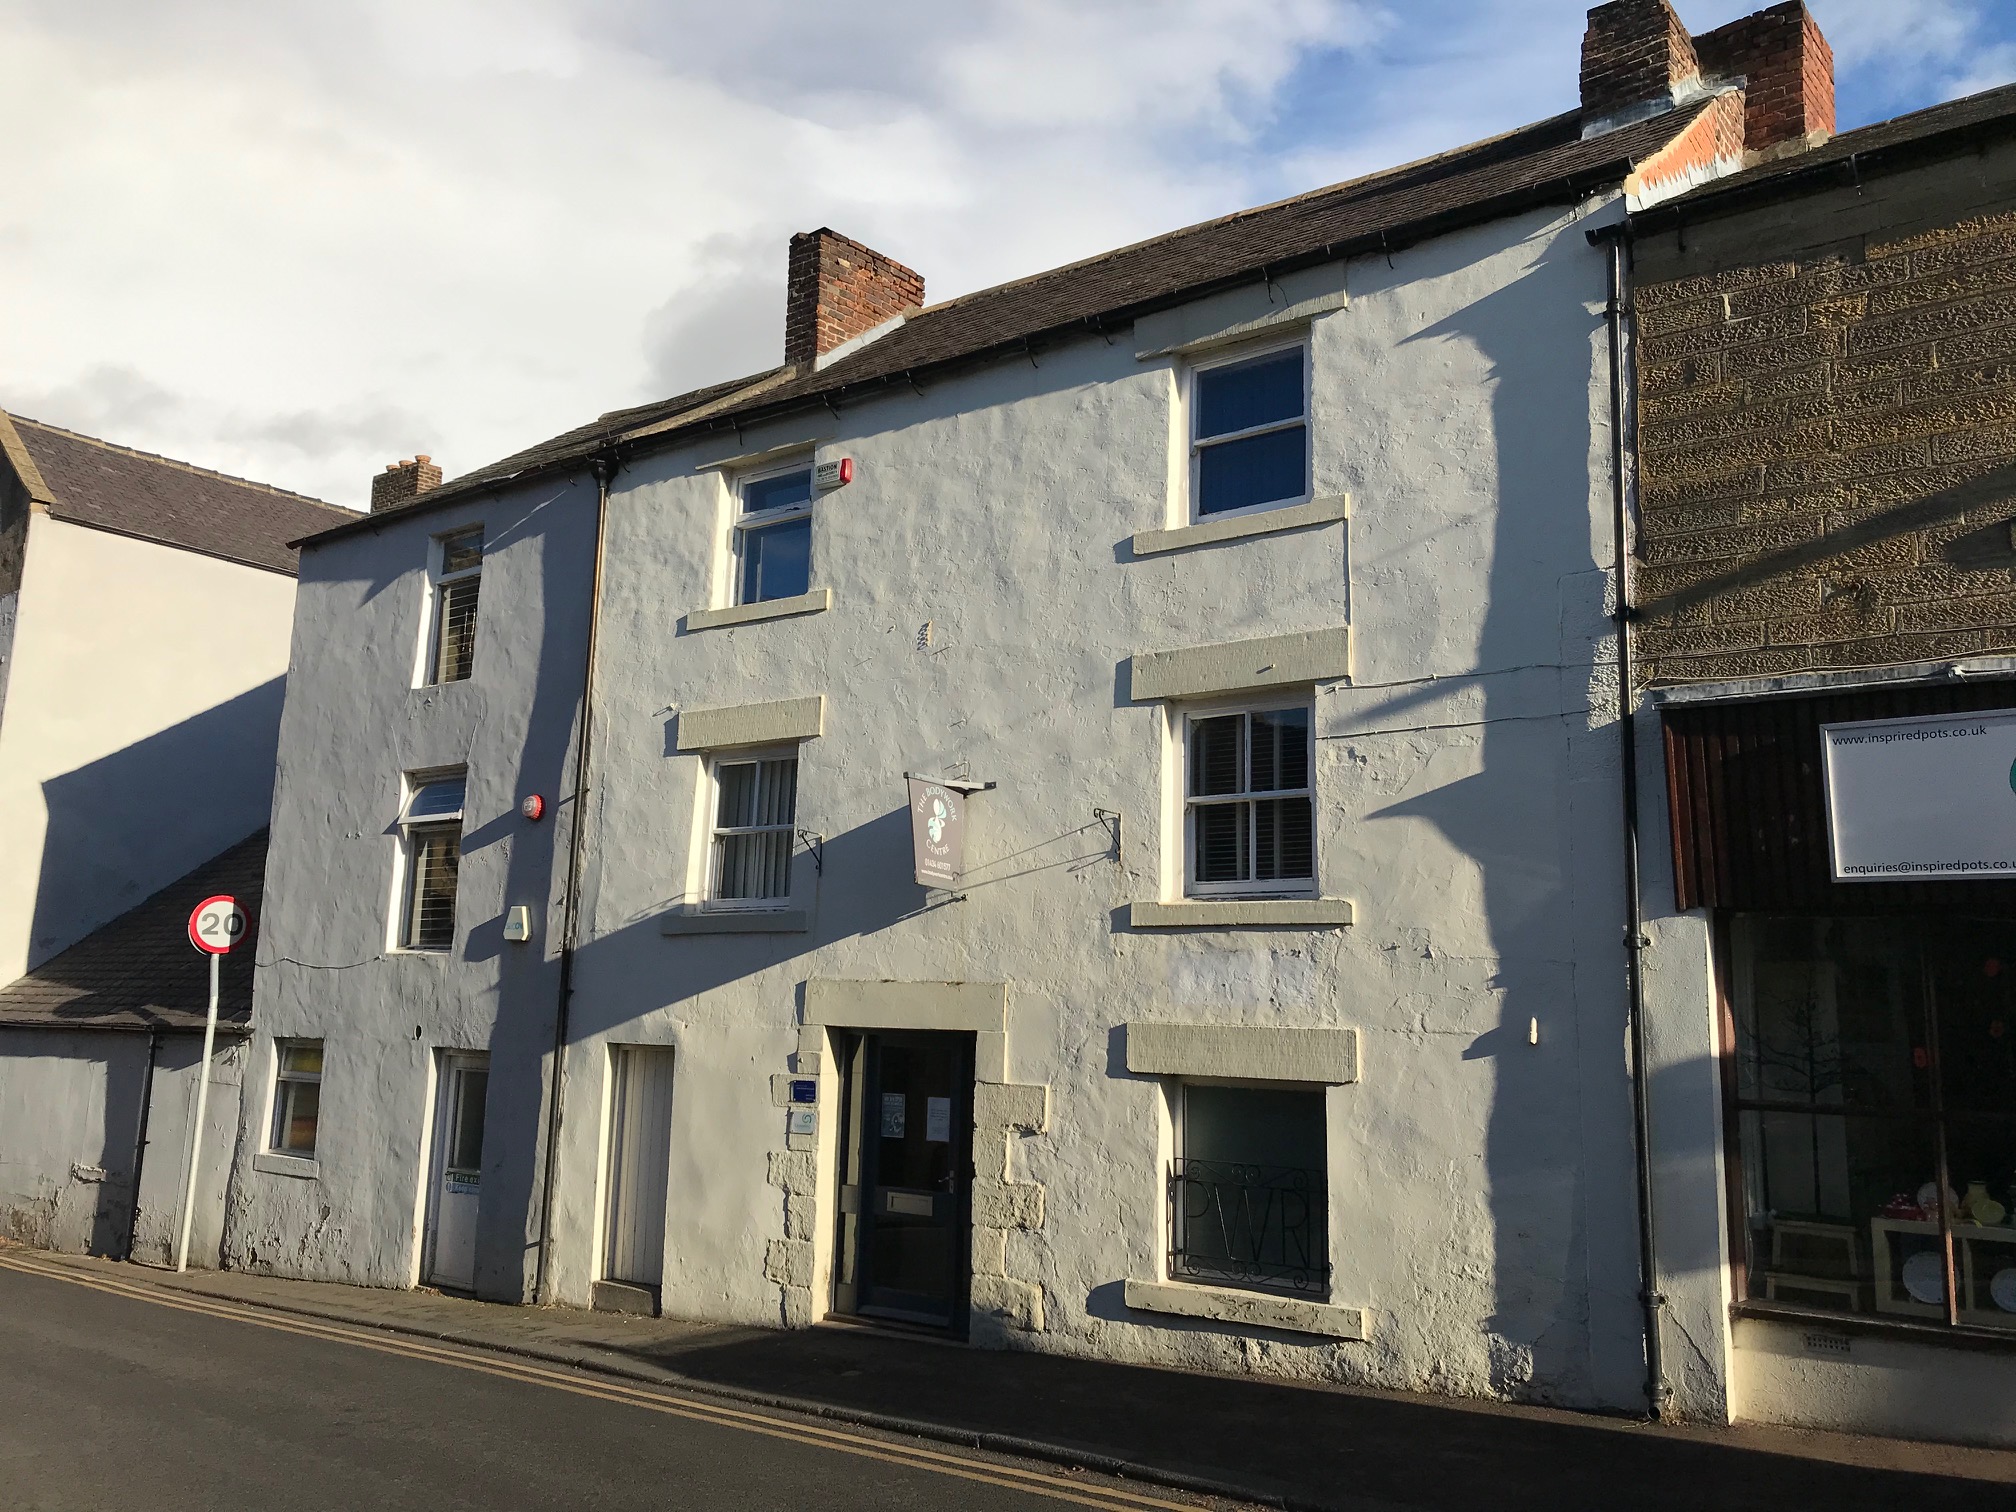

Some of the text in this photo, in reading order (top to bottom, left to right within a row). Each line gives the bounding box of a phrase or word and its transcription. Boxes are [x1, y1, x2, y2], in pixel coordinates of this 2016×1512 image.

[1833, 725, 1986, 745] www.inspriredpots.co.uk
[918, 786, 957, 821] THE BODYWORK
[926, 839, 949, 856] CENTRE
[202, 912, 243, 935] 20
[456, 1174, 468, 1182] Fire
